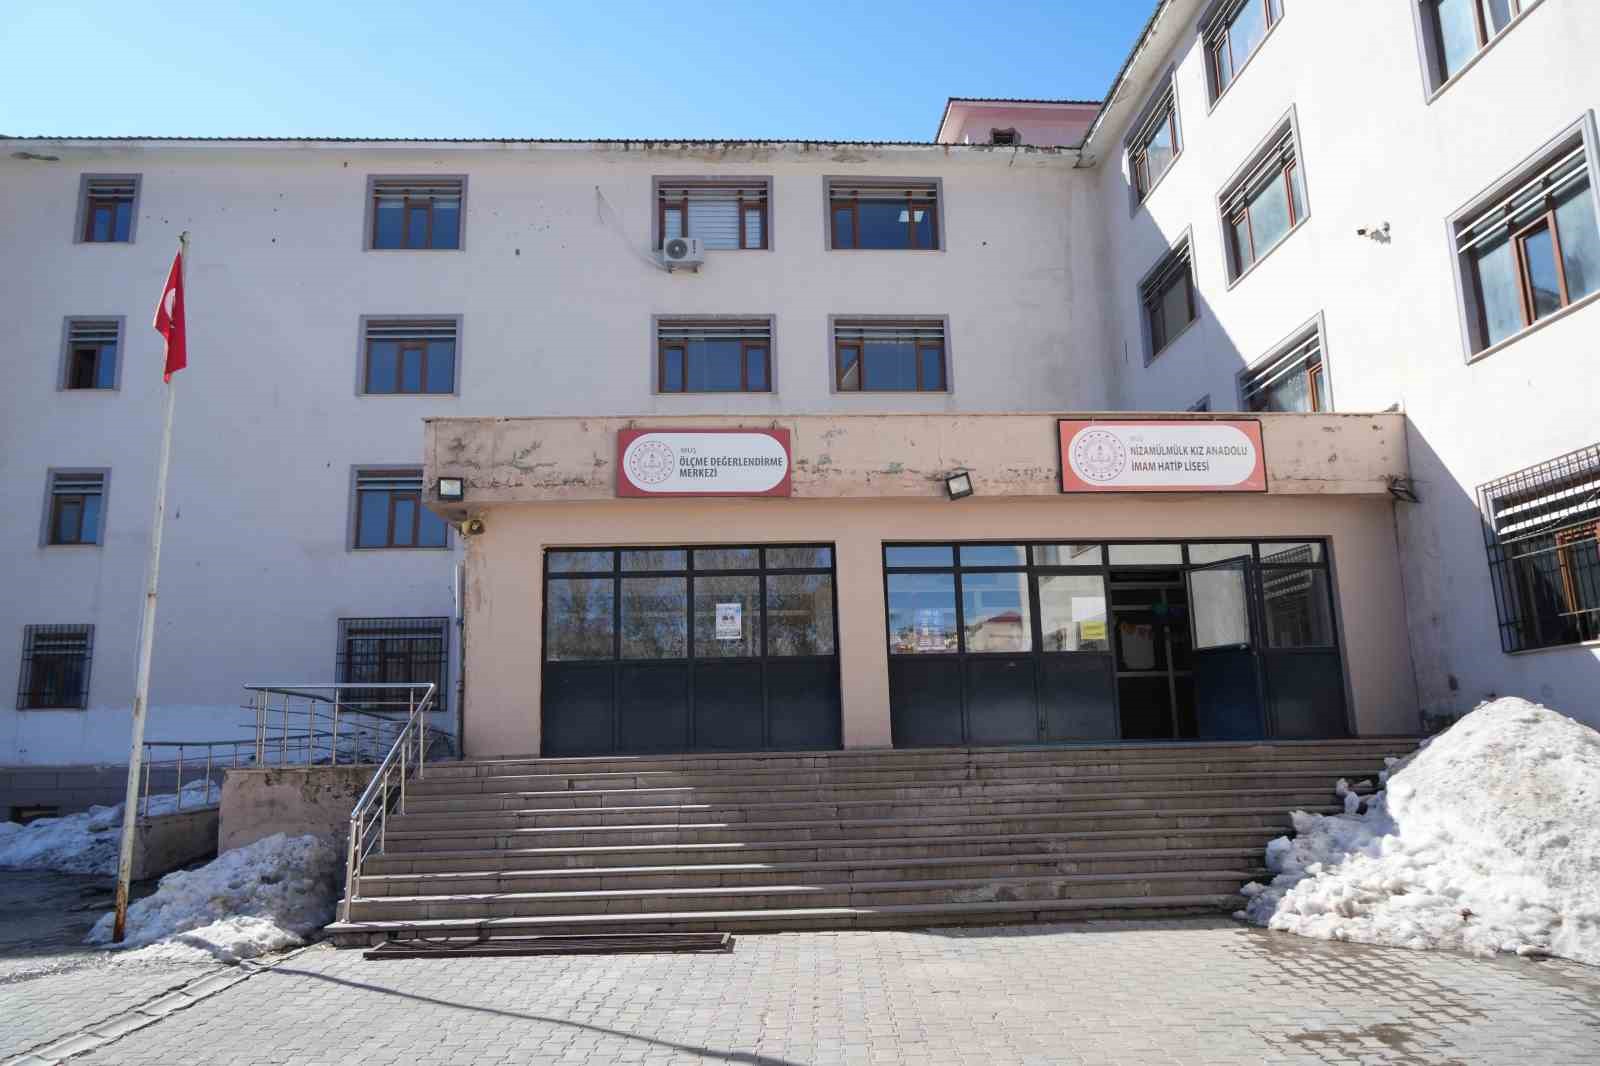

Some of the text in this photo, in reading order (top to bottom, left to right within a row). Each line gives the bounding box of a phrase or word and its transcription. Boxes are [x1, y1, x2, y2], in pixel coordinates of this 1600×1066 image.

[1190, 446, 1204, 456] KIZ
[1206, 446, 1248, 456] ANADOLU
[679, 455, 783, 468] ÖLÇME DEĞERLENDİRME
[1131, 459, 1210, 472] İMAM HATİP LİSESİ
[679, 466, 718, 478] MERKEZİ
